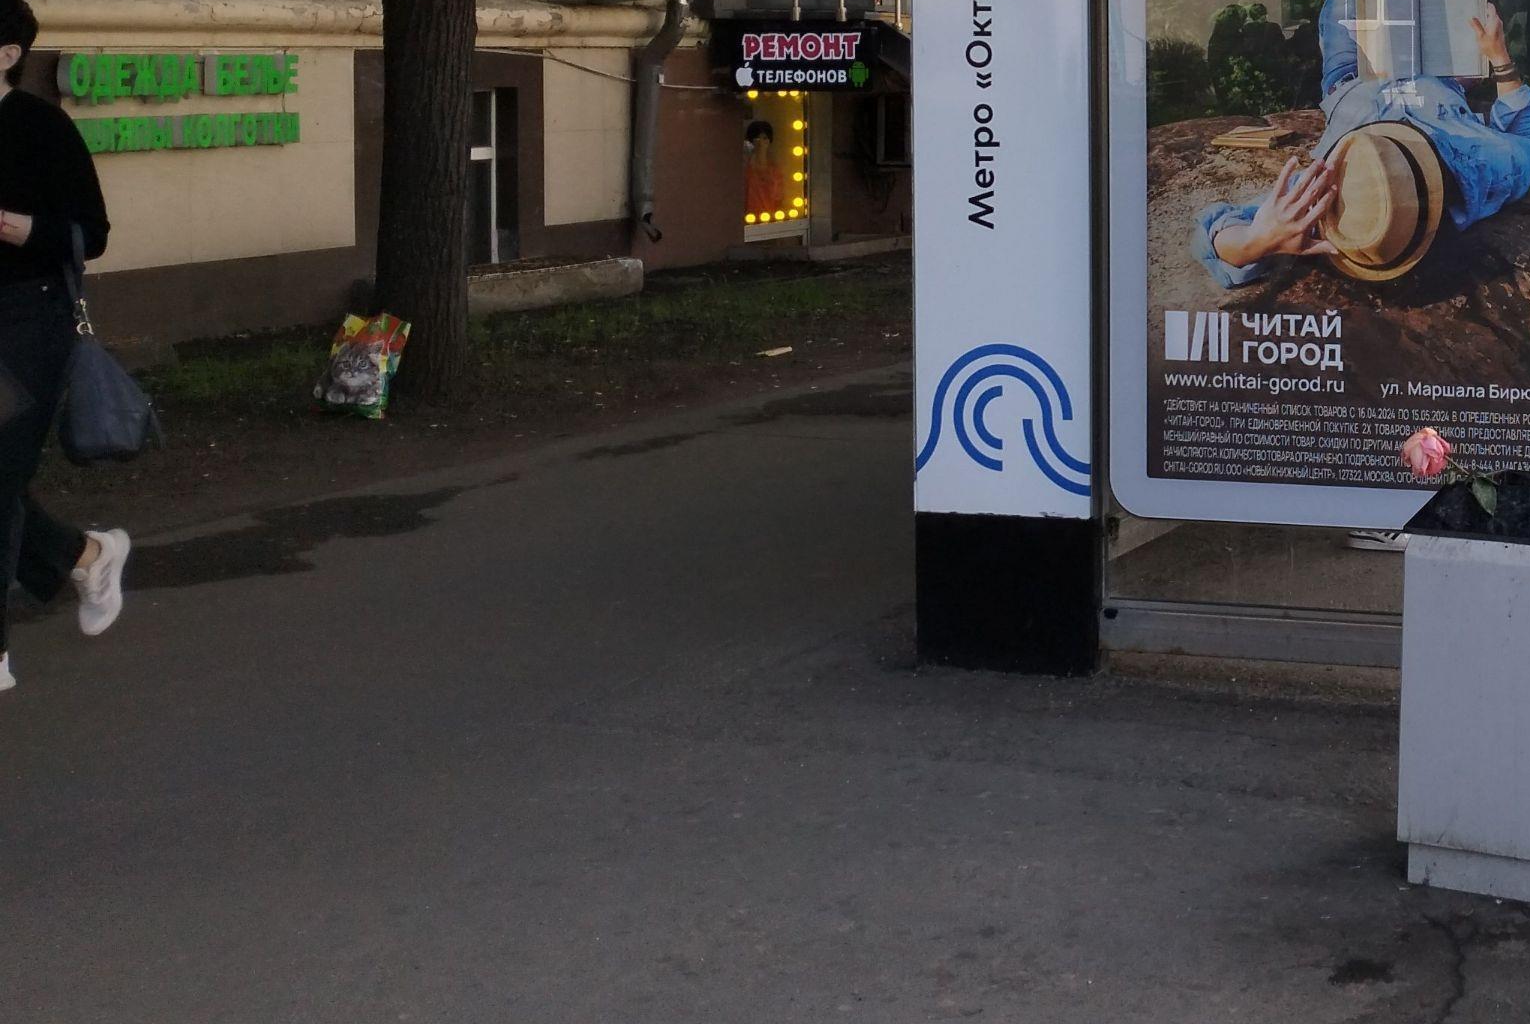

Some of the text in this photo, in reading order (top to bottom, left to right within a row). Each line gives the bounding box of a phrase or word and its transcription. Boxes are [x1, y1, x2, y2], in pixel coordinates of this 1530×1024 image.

[742, 32, 861, 60] РЕМОНТ
[69, 53, 299, 103] ОДЕЖДА БЕЛЬЕ
[756, 69, 847, 84] ТЕЛЕФОНОВ
[968, 103, 1000, 230] Метро
[1241, 309, 1342, 338] ЧИТАЙ
[1242, 341, 1344, 371] ГОРОД
[1164, 372, 1345, 394] www.chitai-gorod.ru
[1380, 383, 1403, 398] ул.
[1407, 381, 1485, 400] Маршала
[1209, 401, 1219, 411] НА
[1221, 401, 1279, 414] ОГРАНИЧЕННЫЙ
[1281, 404, 1312, 416] СПИСОК
[1314, 405, 1347, 417] ТОВАРОВ
[1349, 407, 1355, 417] С
[1358, 407, 1395, 419] 16.04.2024
[1398, 409, 1409, 420] ДО
[1412, 409, 1449, 422] 15.05.2024
[1452, 411, 1458, 422] В
[1460, 411, 1520, 425] ОПРЕДЕЛЕННЫХ
[1229, 417, 1245, 428] ПРИ
[1248, 418, 1321, 432] ЕДИНОВРЕМЕННОЙ
[1323, 421, 1359, 434] ПОКУПКЕ
[1232, 433, 1242, 444] ПО
[1245, 433, 1290, 446] СТОИМОСТИ
[1319, 437, 1349, 450] СКИДКИ
[1350, 439, 1361, 450] ПО
[1363, 439, 1392, 451] ДРУГИМ
[1460, 443, 1511, 456] ЛОЯЛЬНОСТИ
[1513, 445, 1522, 456] НЕ
[1226, 463, 1242, 475] ООО
